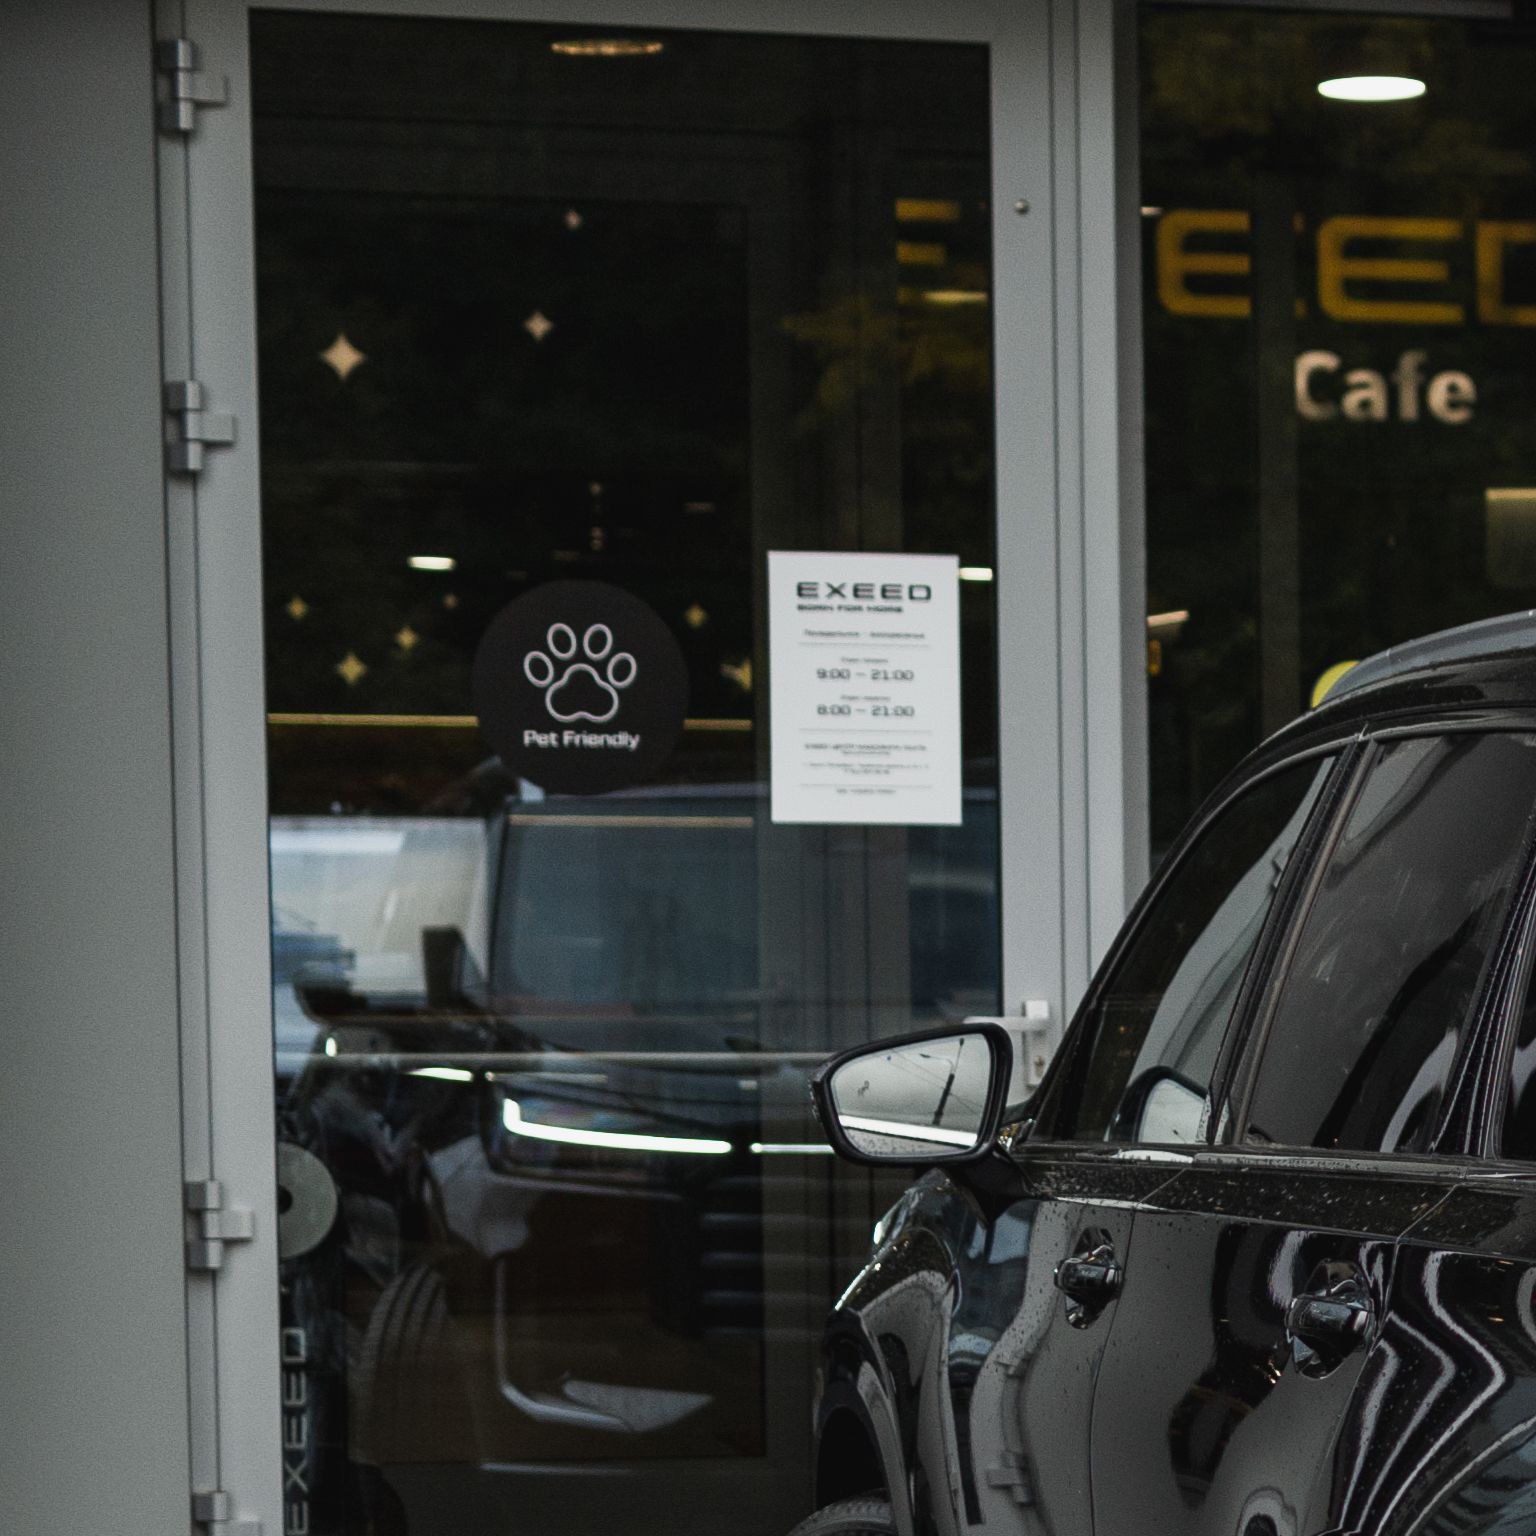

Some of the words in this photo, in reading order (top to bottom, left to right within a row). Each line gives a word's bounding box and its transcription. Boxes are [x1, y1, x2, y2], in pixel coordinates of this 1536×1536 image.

[1295, 350, 1477, 423] Cafe
[797, 581, 932, 602] EXEED
[870, 669, 914, 681] 21:00
[870, 705, 915, 717] 21:00
[523, 730, 559, 748] Pet
[563, 730, 640, 752] Friendly
